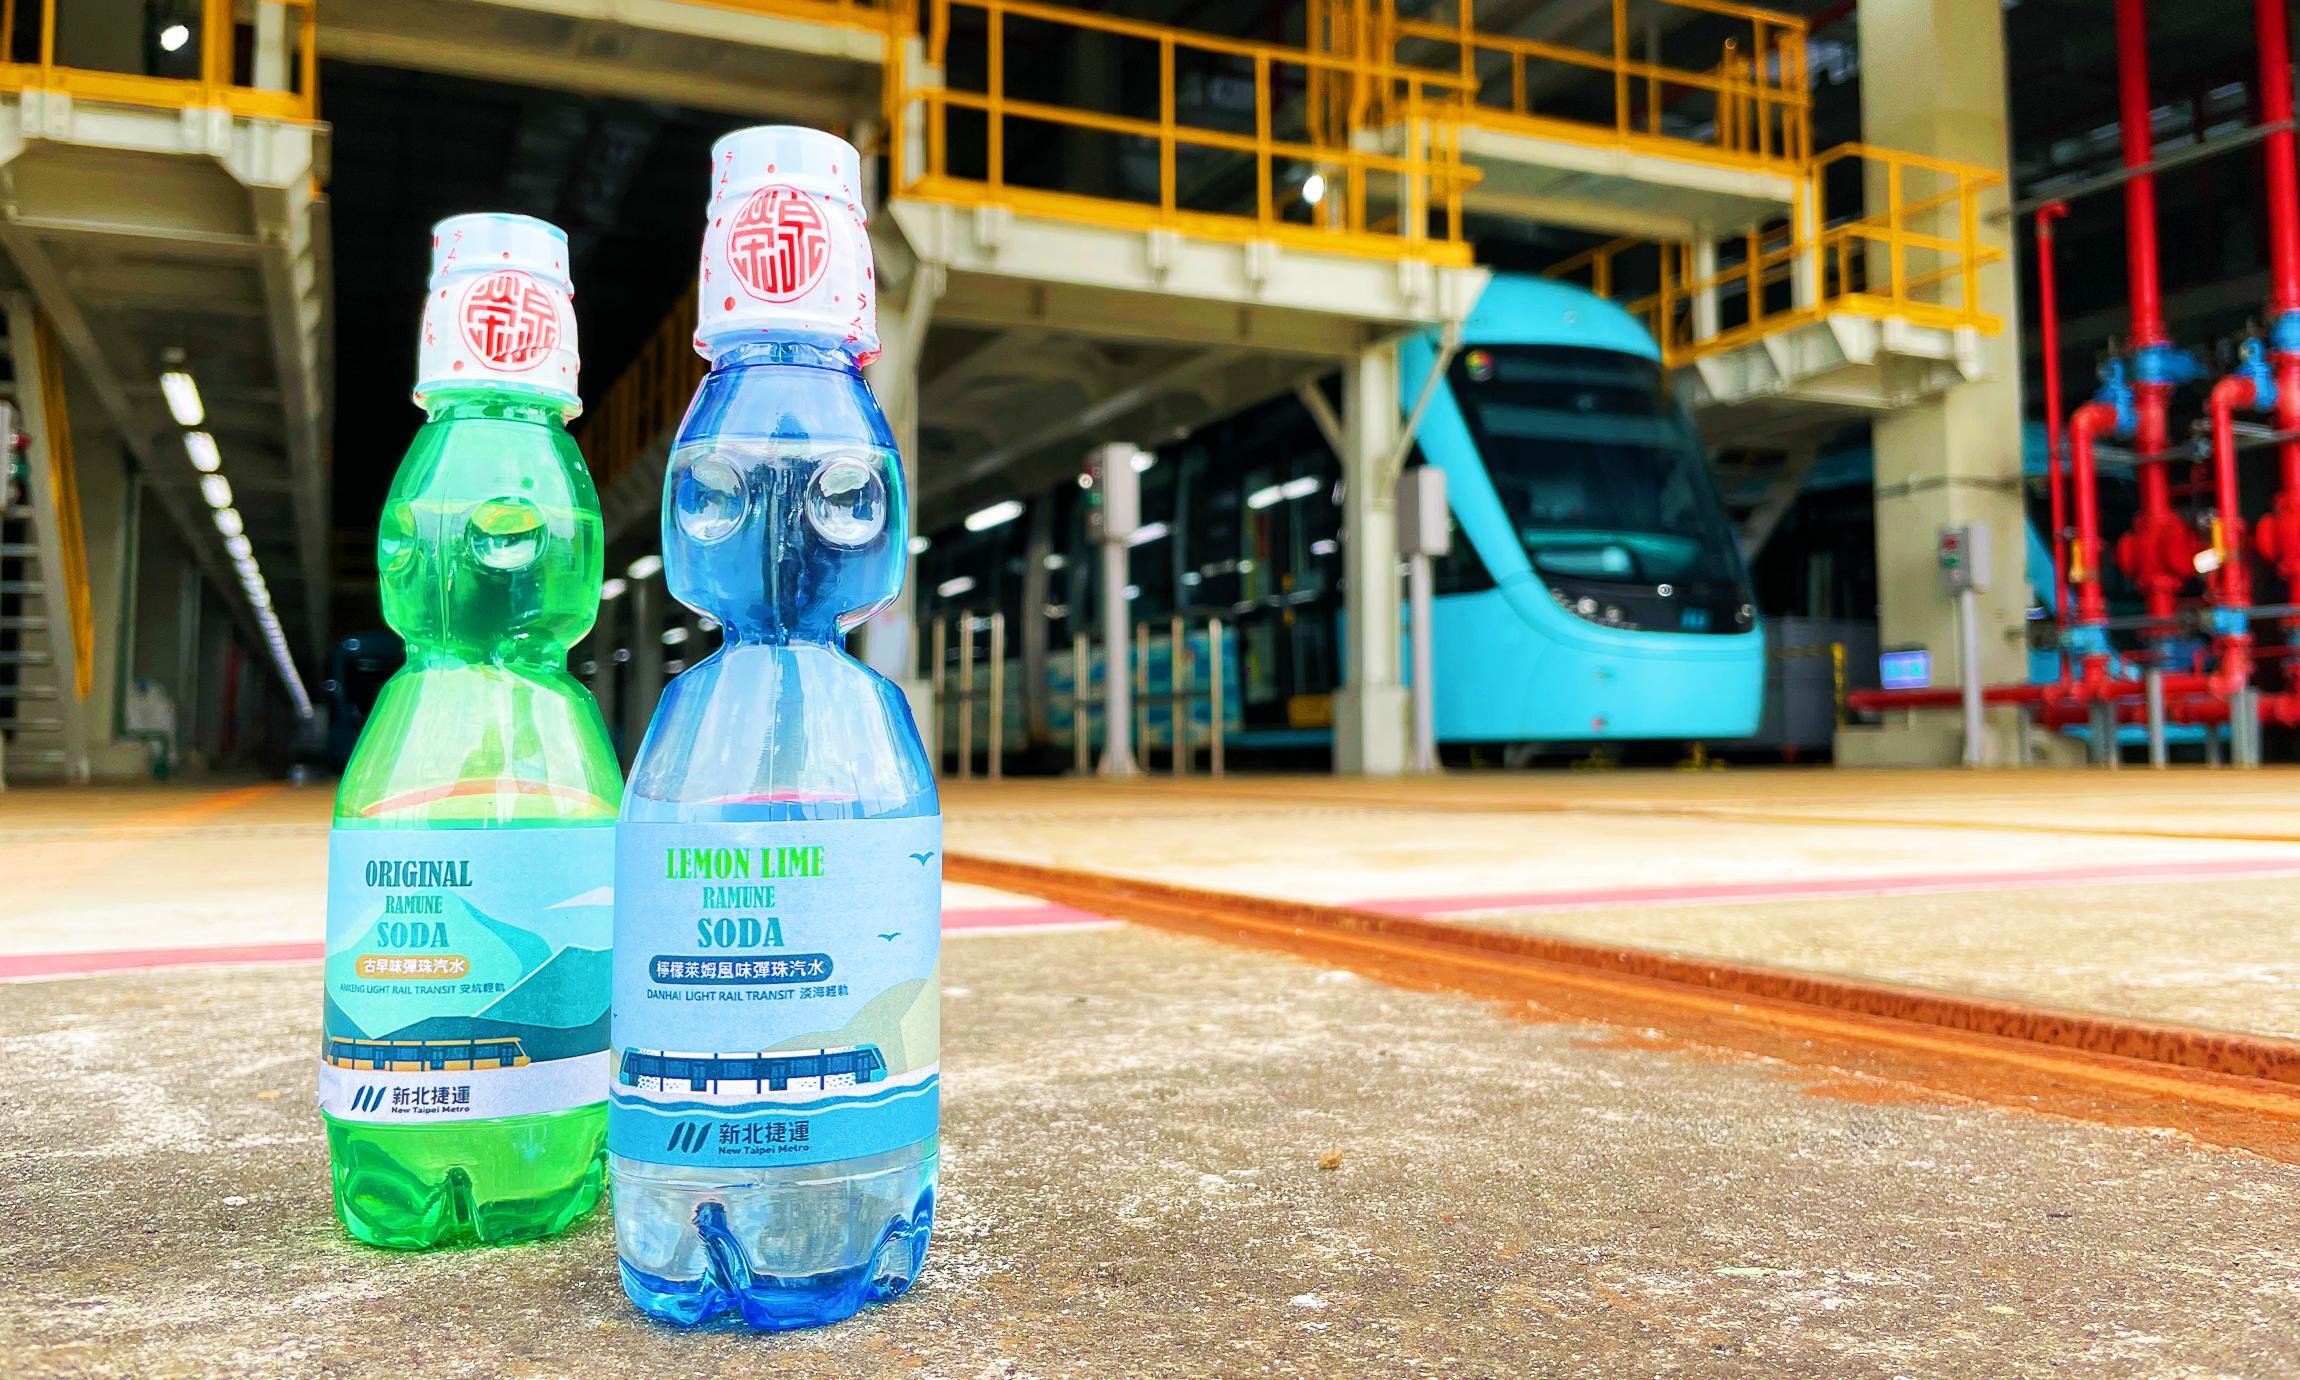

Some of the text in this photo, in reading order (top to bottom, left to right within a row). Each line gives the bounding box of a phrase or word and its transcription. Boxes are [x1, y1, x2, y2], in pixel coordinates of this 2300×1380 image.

[666, 845, 826, 880] LEMON LIME
[365, 860, 473, 888] ORIGINAL
[385, 895, 443, 915] RAMUNE
[702, 885, 776, 910] RAMUNE
[377, 921, 450, 949] SODA
[697, 916, 785, 949] SODA
[363, 958, 466, 975] 古早味彈珠汽水
[656, 958, 826, 980] 檸檬萊姆風味彈珠汽水
[339, 983, 365, 994] ANKENG
[366, 985, 391, 994] LIGHT
[392, 985, 413, 995] RAIL
[415, 984, 457, 995] TRANSIT
[647, 984, 849, 1001] DANHAI LIGHT RAIL TRANSIT 淡海輕軌
[392, 1085, 471, 1106] 新北捷運
[391, 1106, 411, 1114] New
[412, 1106, 440, 1115] Taipei
[718, 1120, 809, 1145] 新北捷運
[718, 1144, 810, 1156] New Taipei Metro
